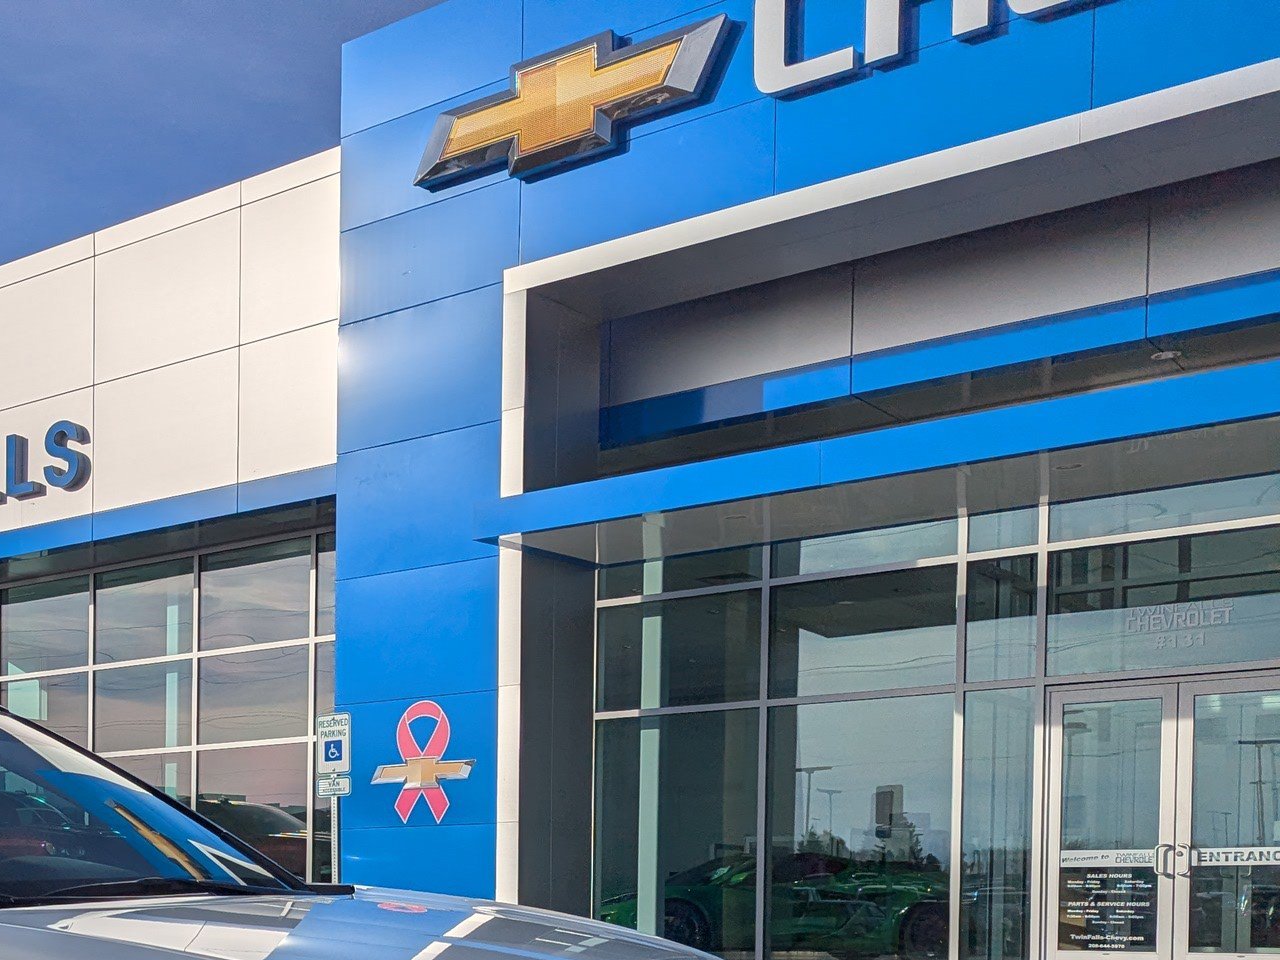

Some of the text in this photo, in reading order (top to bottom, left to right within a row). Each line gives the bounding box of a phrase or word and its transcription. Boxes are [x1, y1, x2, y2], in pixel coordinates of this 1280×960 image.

[1126, 606, 1235, 633] CHEVROLET
[318, 718, 349, 729] RESERVED
[320, 728, 347, 738] PARKING
[1061, 854, 1099, 864] Welcome
